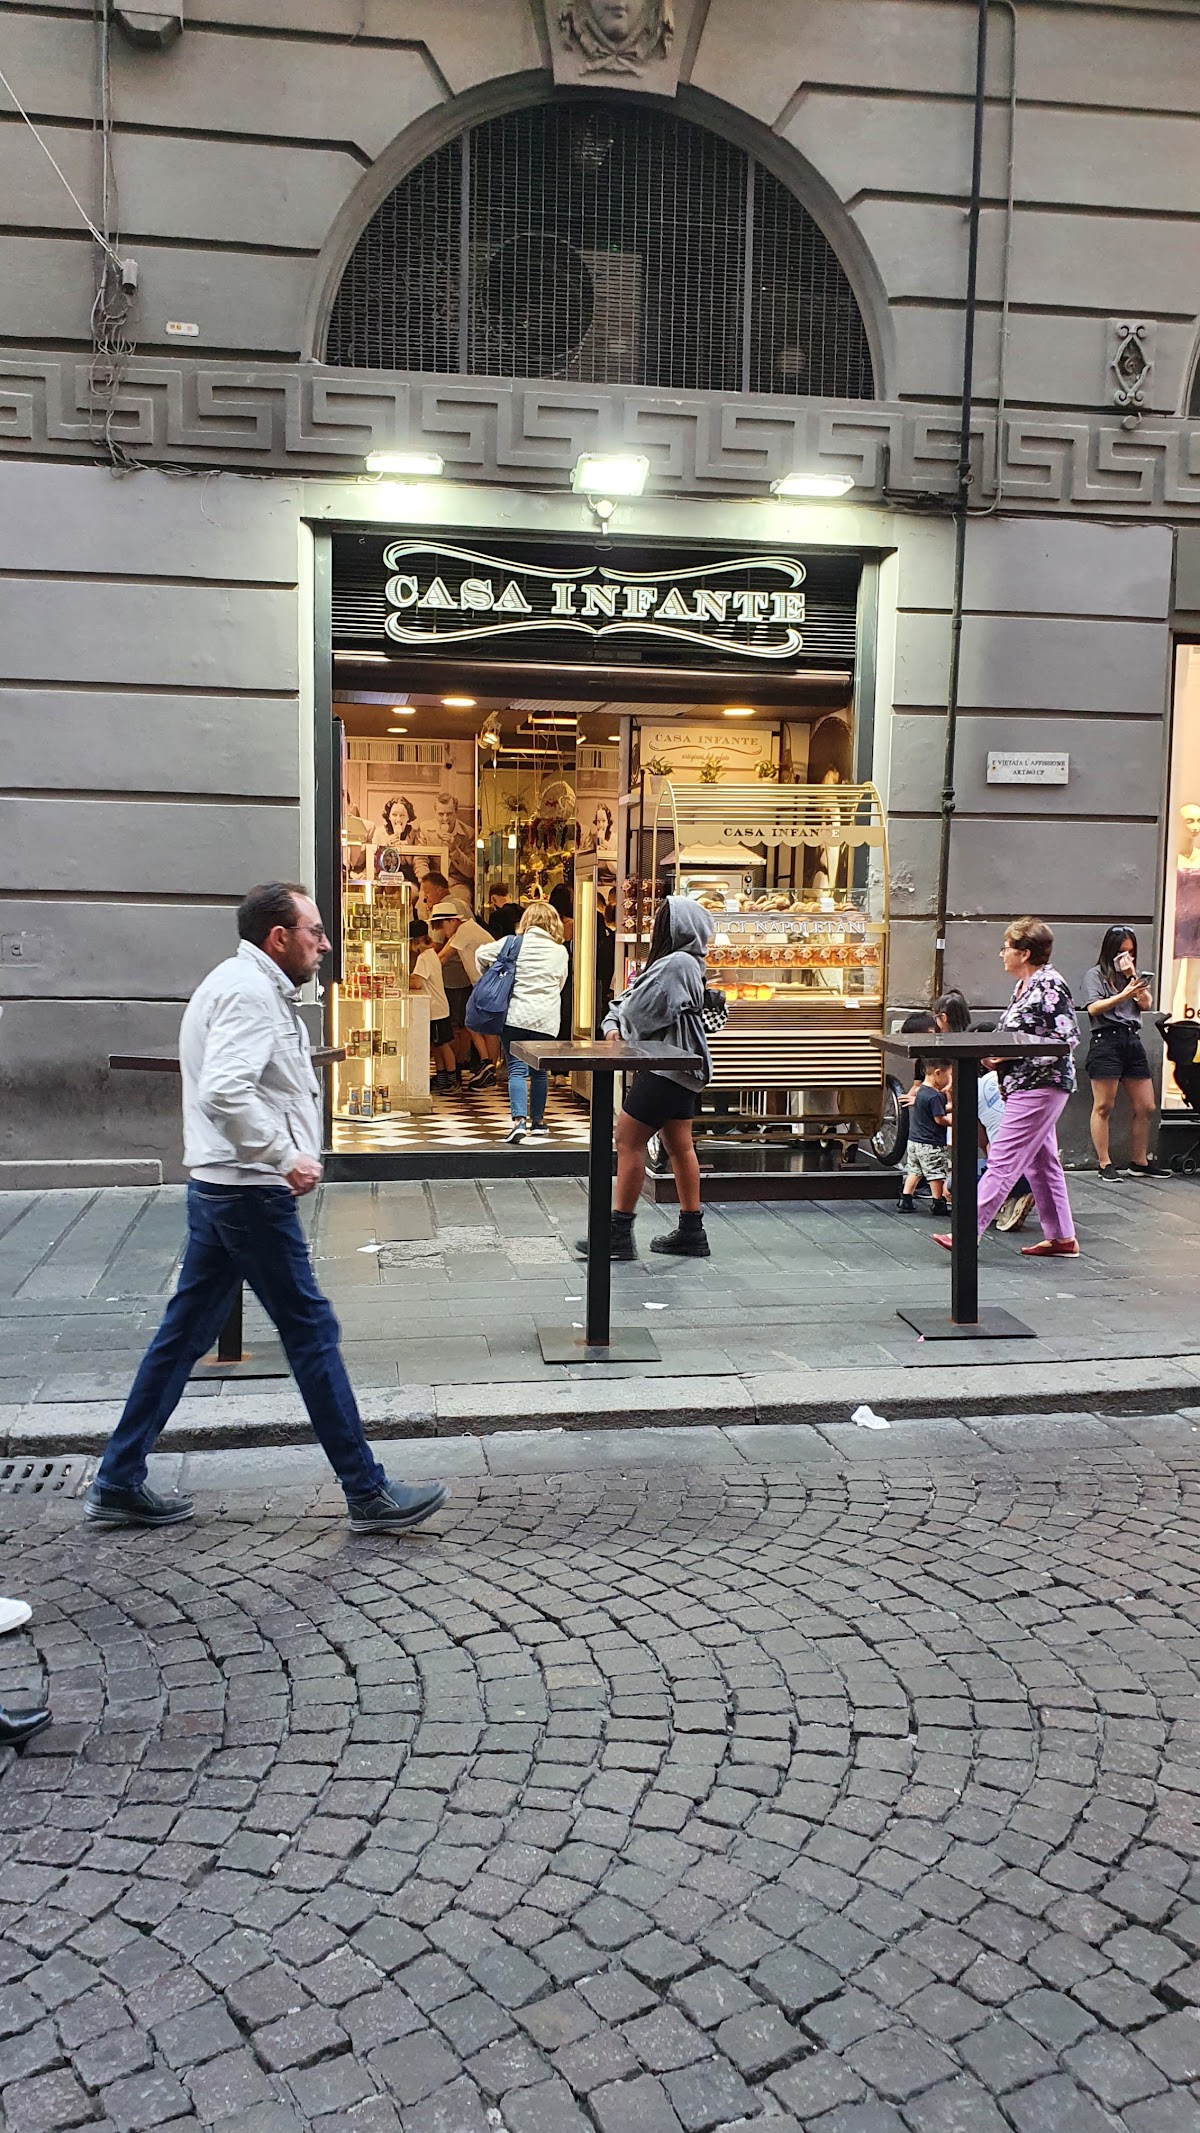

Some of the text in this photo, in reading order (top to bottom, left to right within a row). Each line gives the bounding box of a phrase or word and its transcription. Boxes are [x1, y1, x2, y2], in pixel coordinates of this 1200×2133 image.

[385, 575, 805, 623] CASA INFANTE
[655, 733, 759, 746] CASA INFANTE
[723, 828, 765, 837] CASA
[714, 920, 866, 933] LCI NAPOLETANI
